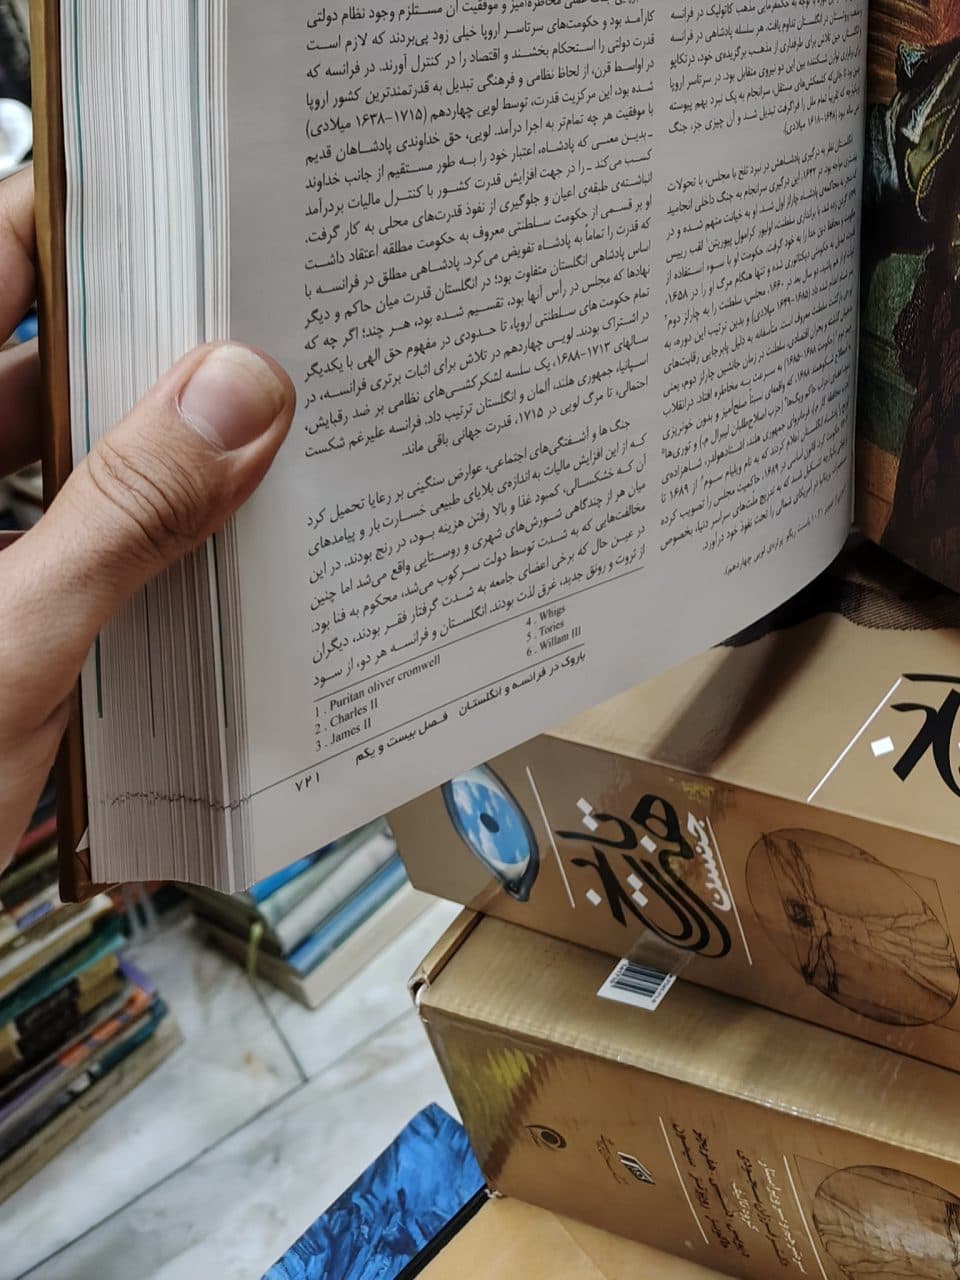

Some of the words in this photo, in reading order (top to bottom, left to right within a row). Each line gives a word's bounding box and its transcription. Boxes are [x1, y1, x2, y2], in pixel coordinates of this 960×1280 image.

[307, 8, 338, 28] دولتی
[341, 6, 365, 26] نظام
[369, 9, 395, 23] وجود
[398, 2, 443, 21] مستلزم
[540, 605, 566, 624] Whigs
[539, 620, 564, 637] Tories
[540, 631, 569, 652] Willam
[571, 626, 581, 640] III
[561, 651, 586, 669] باروک
[511, 668, 546, 690] فرانسه
[550, 664, 559, 677] در
[329, 690, 364, 712] Puritan
[368, 676, 396, 695] oliver
[398, 655, 441, 682] cromwell
[459, 686, 502, 717] انگلستان
[330, 706, 368, 728] Charles
[370, 701, 378, 714] II
[418, 712, 448, 736] فصل
[330, 724, 361, 746] James
[363, 718, 371, 731] II
[387, 729, 417, 748] بیست
[355, 747, 376, 765] یکم
[295, 772, 320, 793] ۷۲۱
[687, 811, 731, 911] جنسن
